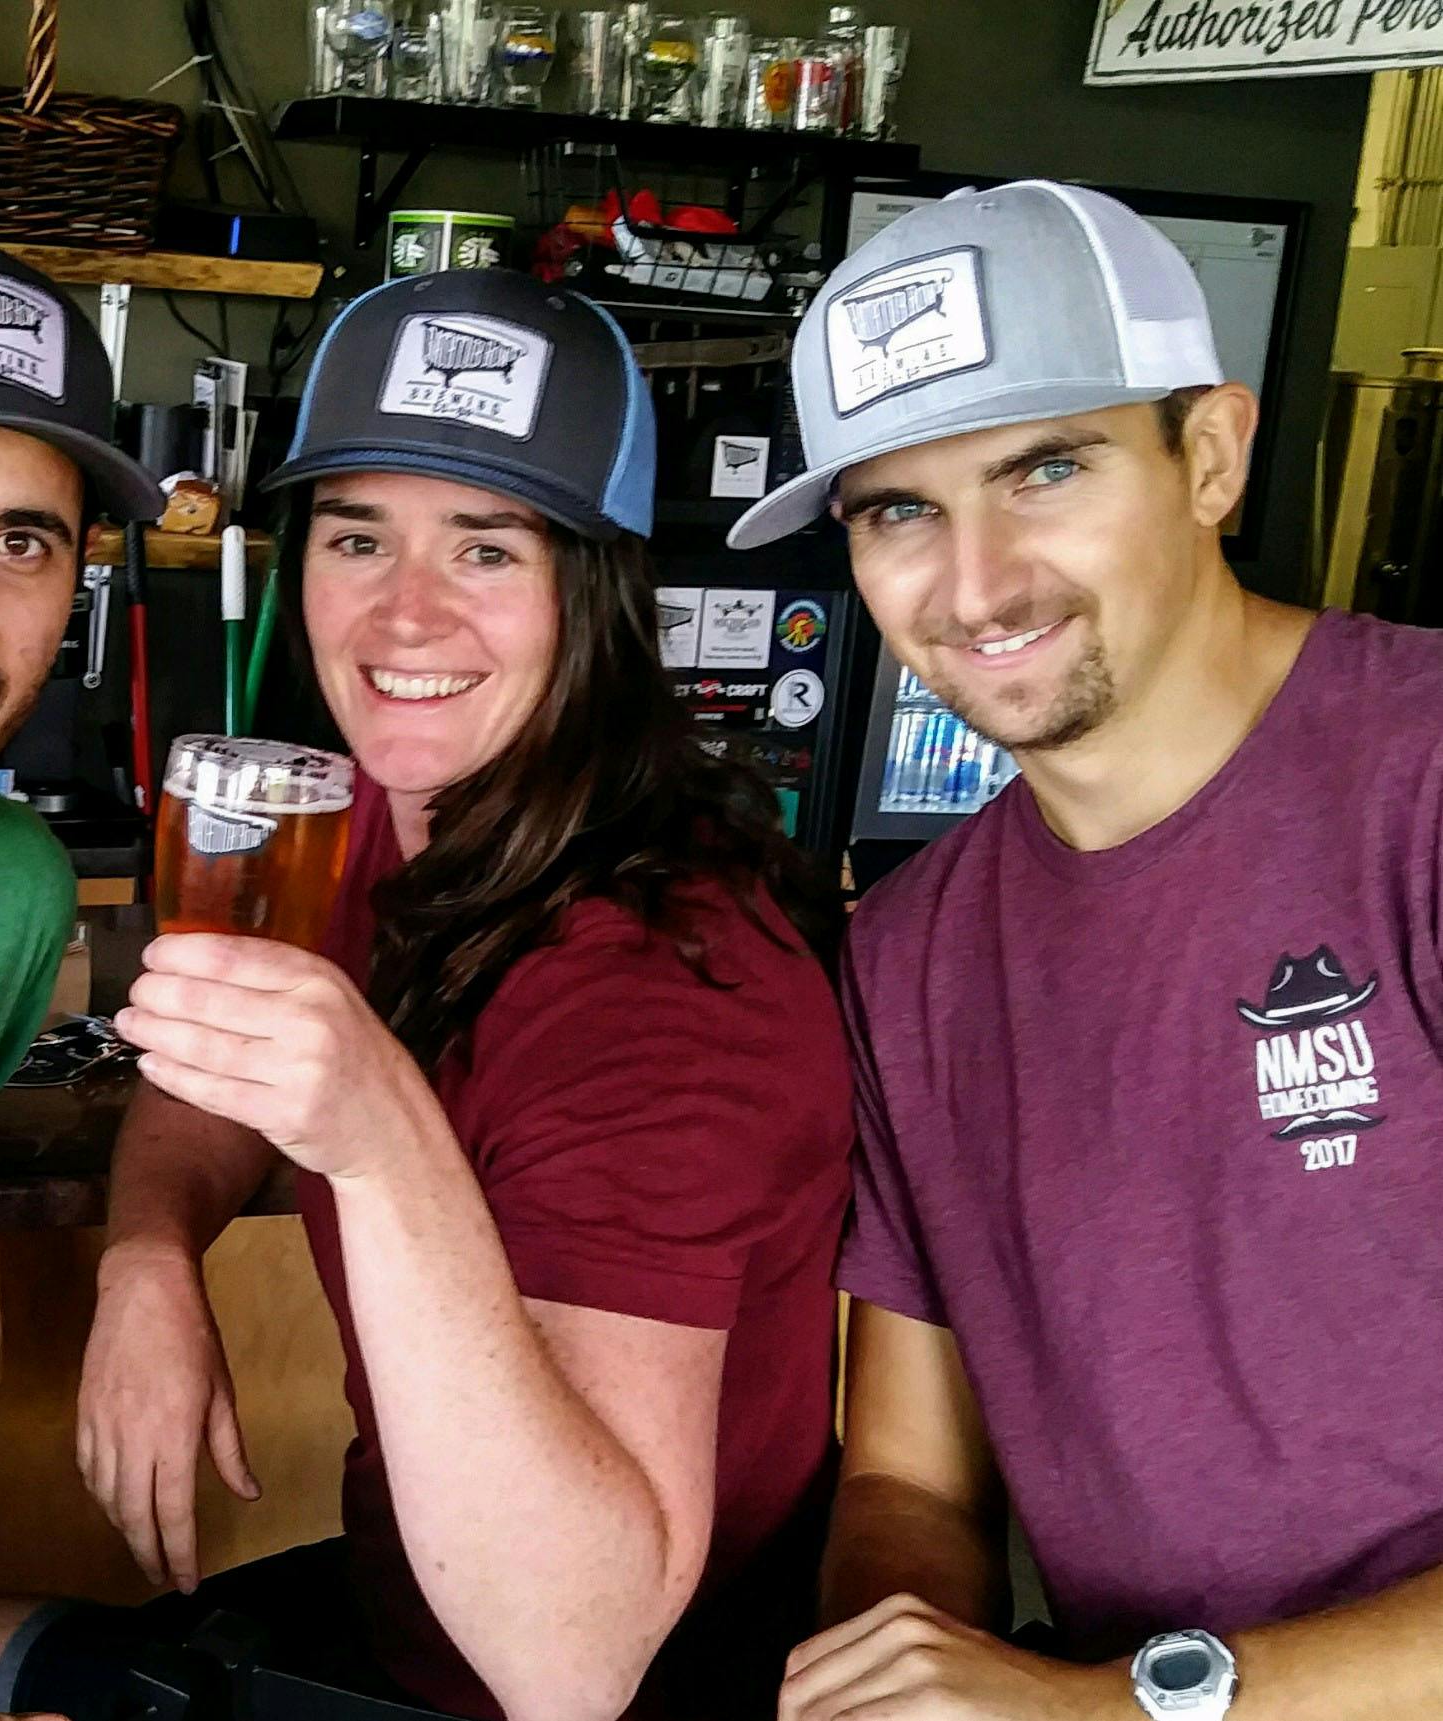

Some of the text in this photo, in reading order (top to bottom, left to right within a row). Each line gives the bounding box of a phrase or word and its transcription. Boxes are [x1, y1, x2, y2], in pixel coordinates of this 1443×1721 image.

[1118, 0, 1346, 57] Authorized
[1255, 1019, 1376, 1094] NMSU
[1299, 1133, 1359, 1172] 2017
